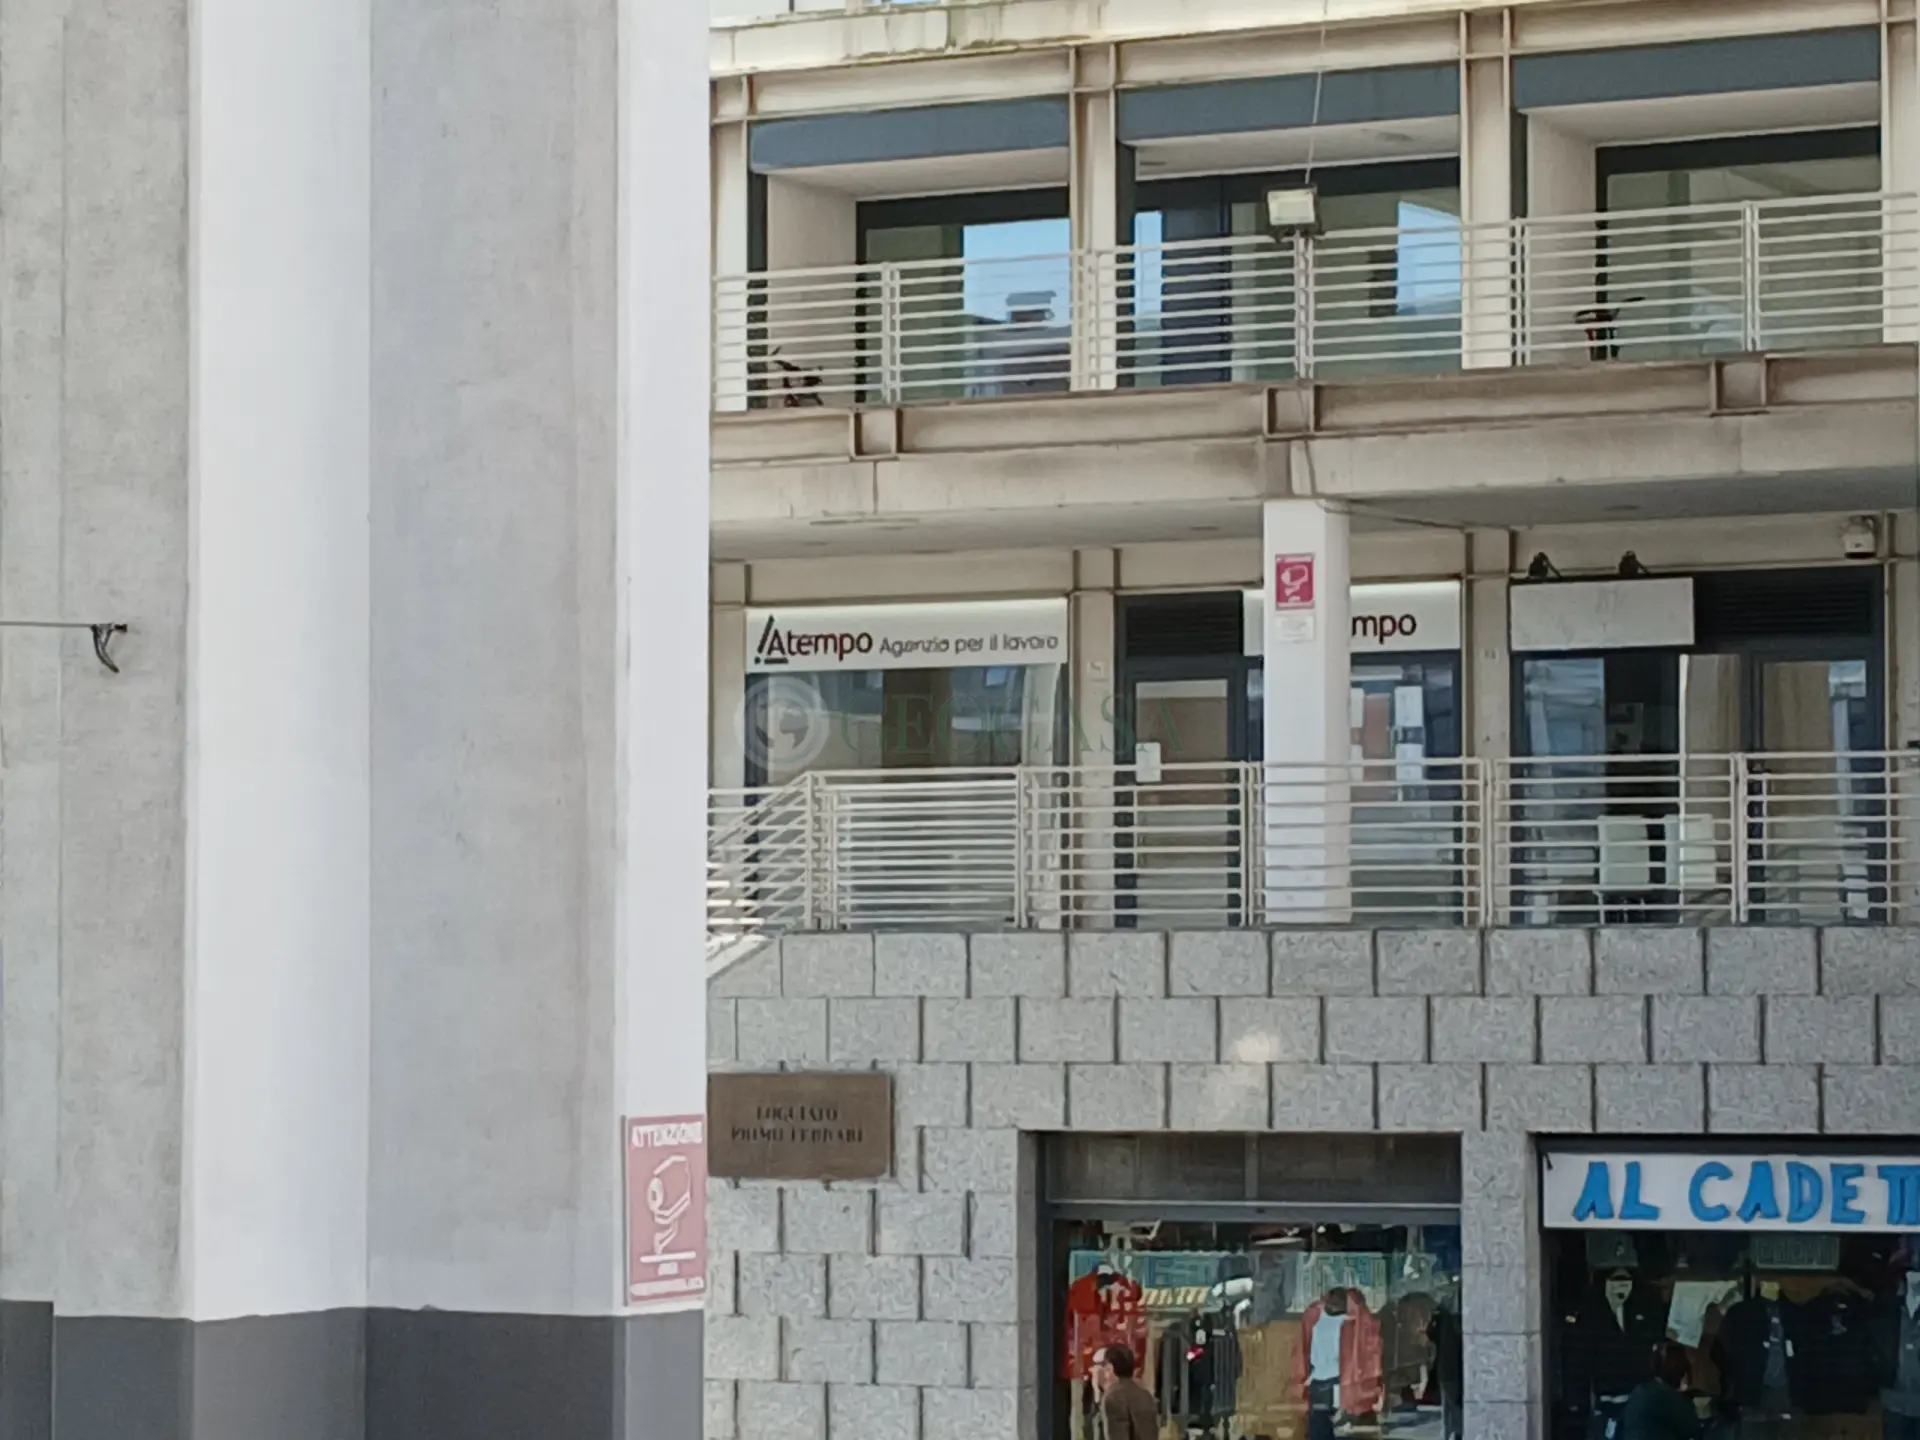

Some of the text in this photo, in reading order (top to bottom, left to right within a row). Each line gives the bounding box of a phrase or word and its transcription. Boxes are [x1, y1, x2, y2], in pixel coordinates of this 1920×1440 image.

[766, 627, 1059, 661] Atempo Agenzia per il lavoro
[1351, 613, 1417, 644] mpo
[1572, 1160, 1660, 1222] AL
